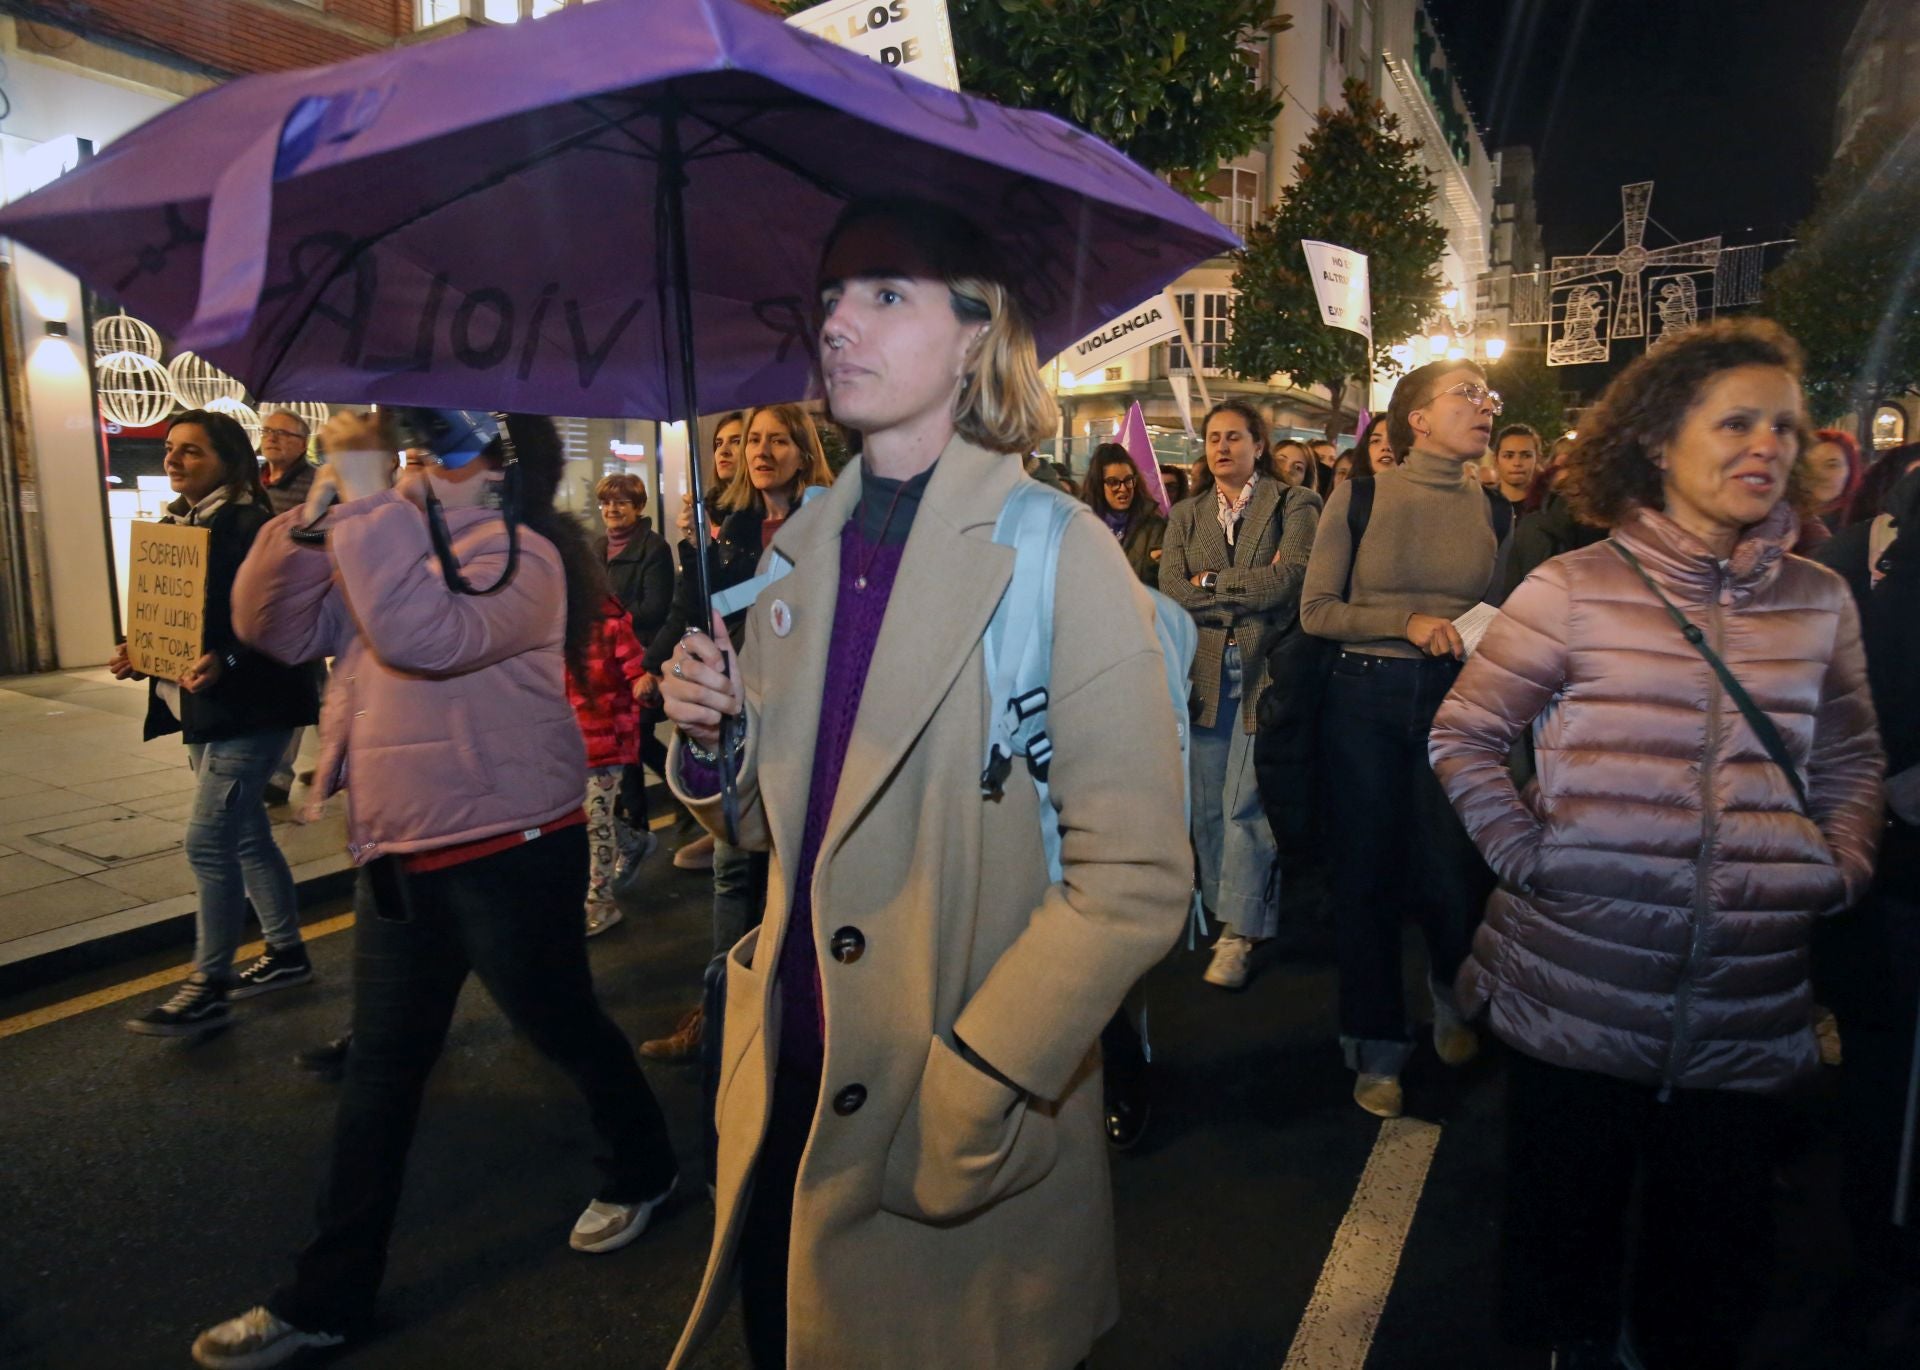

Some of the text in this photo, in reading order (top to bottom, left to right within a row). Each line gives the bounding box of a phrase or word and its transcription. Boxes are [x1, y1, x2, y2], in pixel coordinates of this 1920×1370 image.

[848, 0, 911, 39] LOS
[880, 37, 923, 68] DE
[1076, 308, 1162, 355] VIOLENCIA
[137, 540, 199, 568] SOBREVIVI
[137, 574, 194, 599] AL ABUSO
[136, 602, 197, 631] HOY LUCHO
[135, 629, 197, 661] POR TODAS
[141, 652, 151, 669] NO
